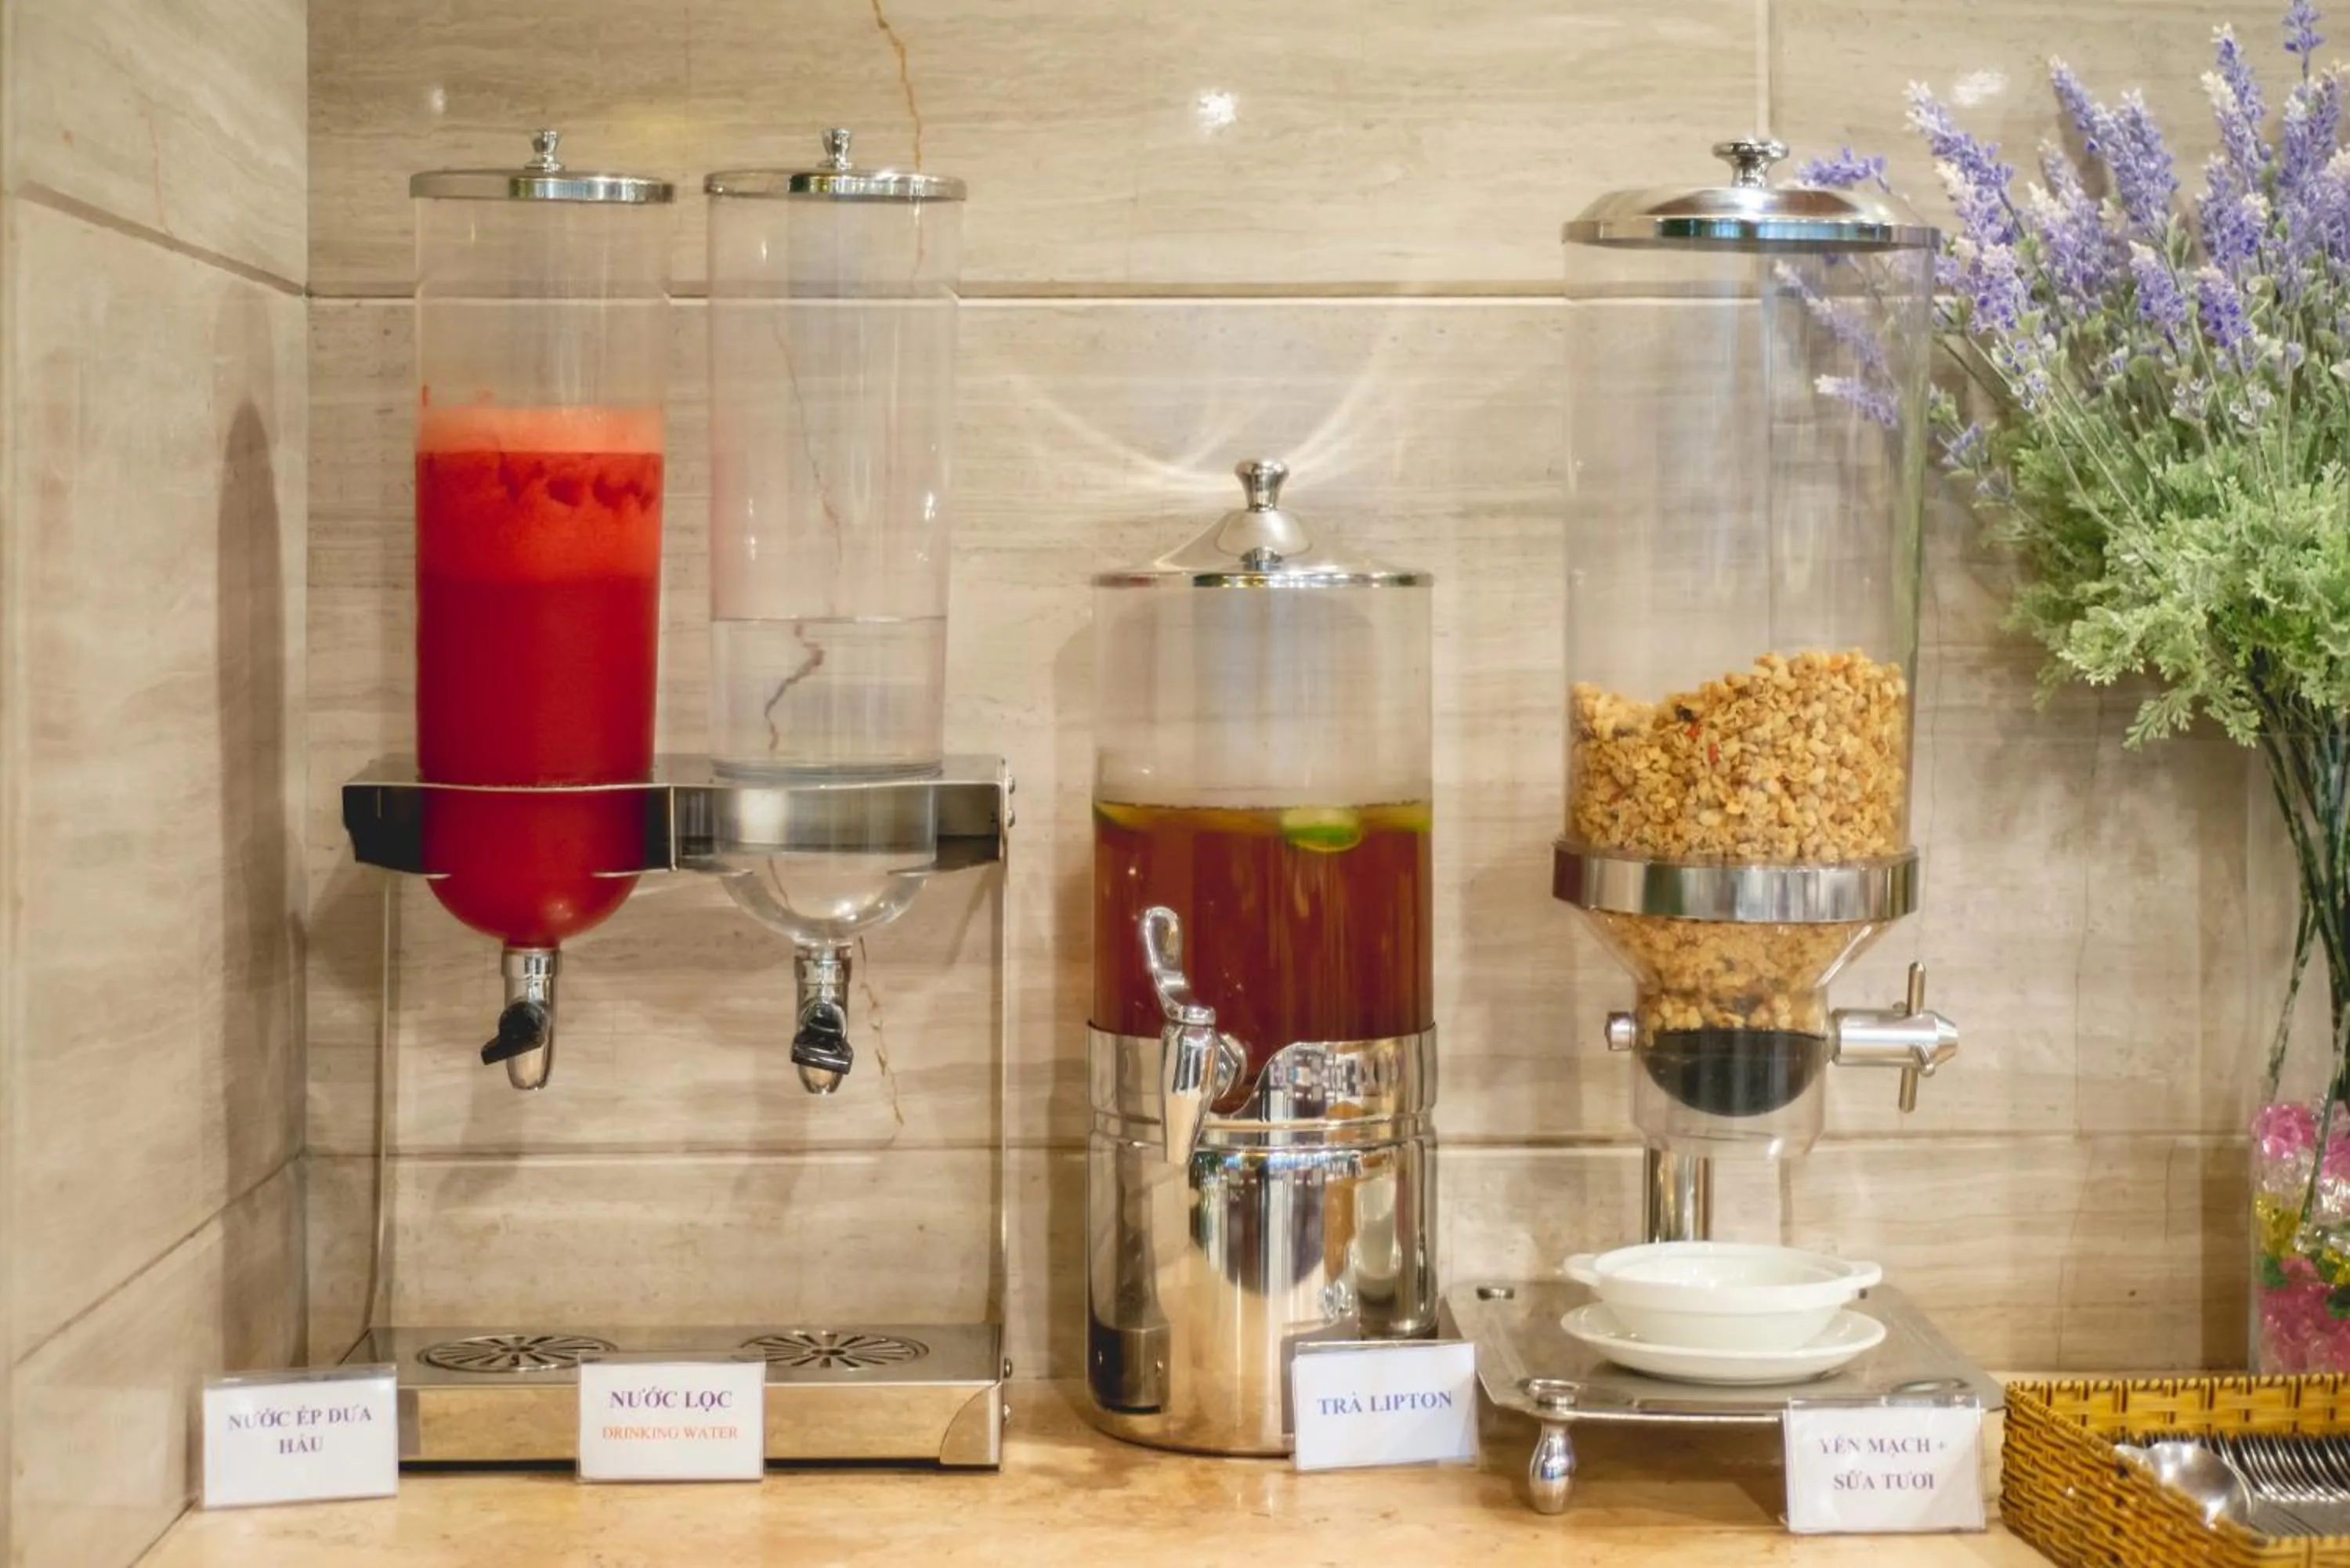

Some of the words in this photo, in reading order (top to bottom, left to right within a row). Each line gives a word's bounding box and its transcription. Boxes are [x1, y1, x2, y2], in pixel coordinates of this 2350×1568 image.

[609, 1385, 678, 1409] NƯỚC
[685, 1390, 732, 1412] LỌC
[1318, 1391, 1362, 1415] TRÀ
[1372, 1390, 1452, 1412] LIPTON
[295, 1404, 322, 1426] ÉP
[328, 1404, 372, 1424] DƯA
[602, 1426, 678, 1440] DRINKING
[683, 1425, 739, 1440] WATER
[1867, 1438, 1930, 1457] MẠCH
